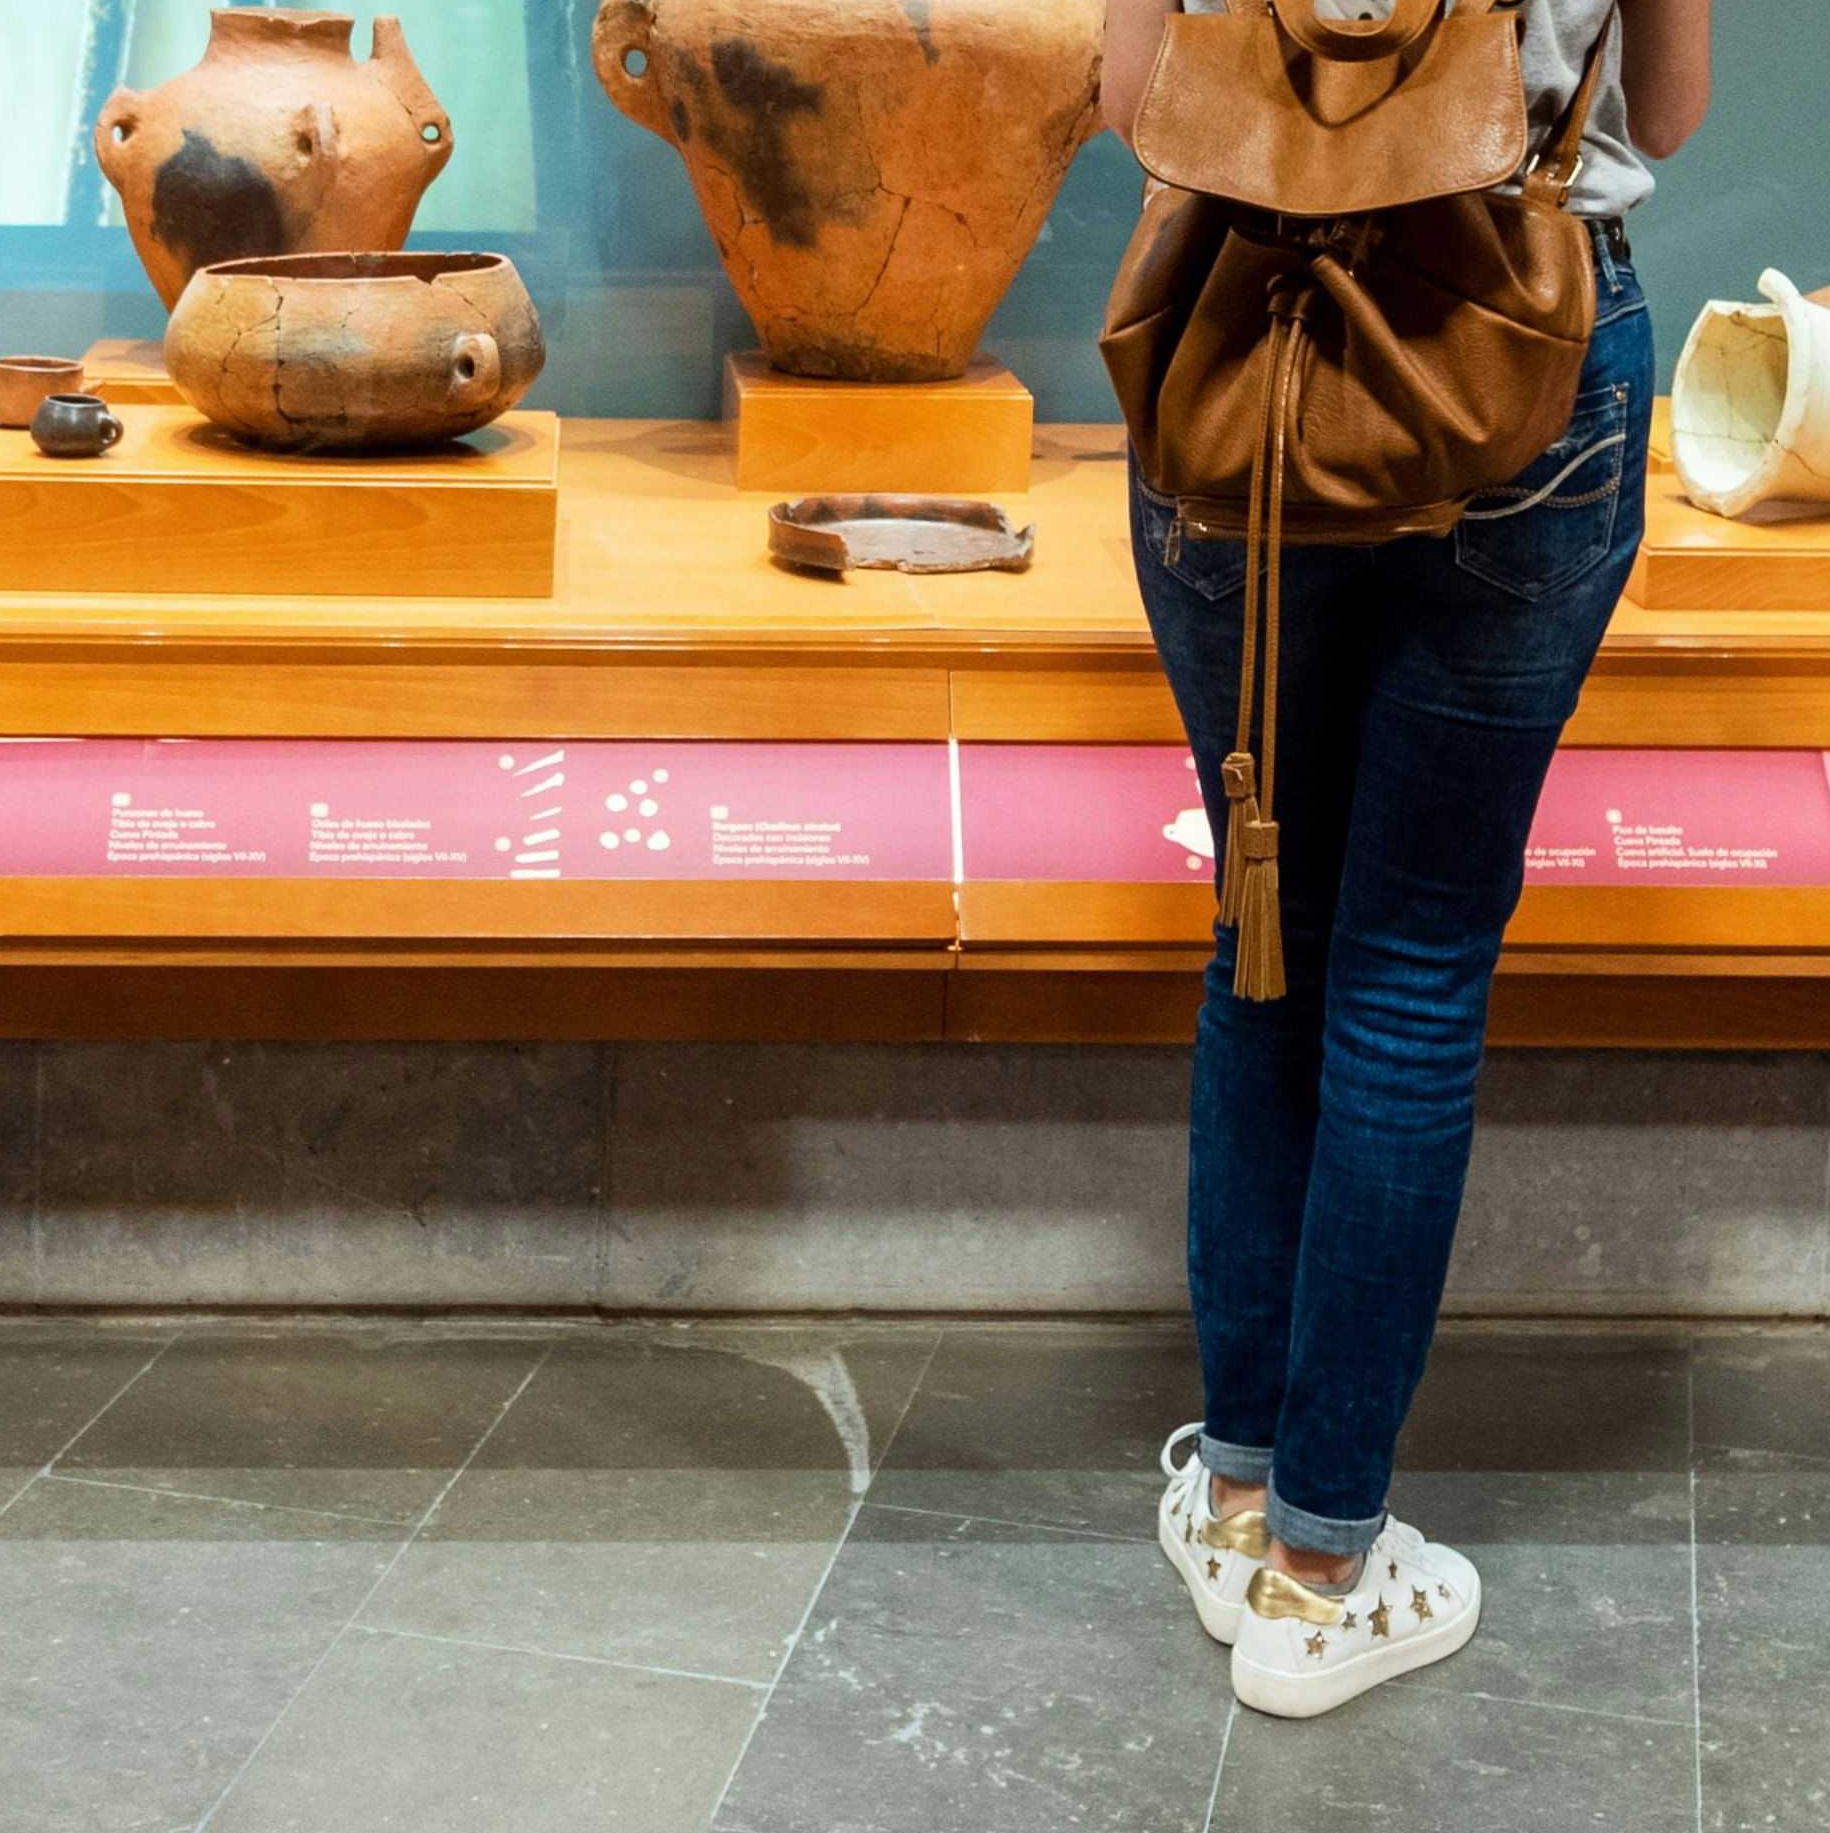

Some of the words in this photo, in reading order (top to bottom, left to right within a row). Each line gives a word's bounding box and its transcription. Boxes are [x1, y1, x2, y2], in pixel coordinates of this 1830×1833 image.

[160, 809, 173, 817] de
[137, 820, 150, 828] de
[341, 820, 354, 828] de
[337, 831, 350, 839] de
[146, 841, 159, 849] de
[348, 841, 360, 850] de
[750, 844, 762, 853] de
